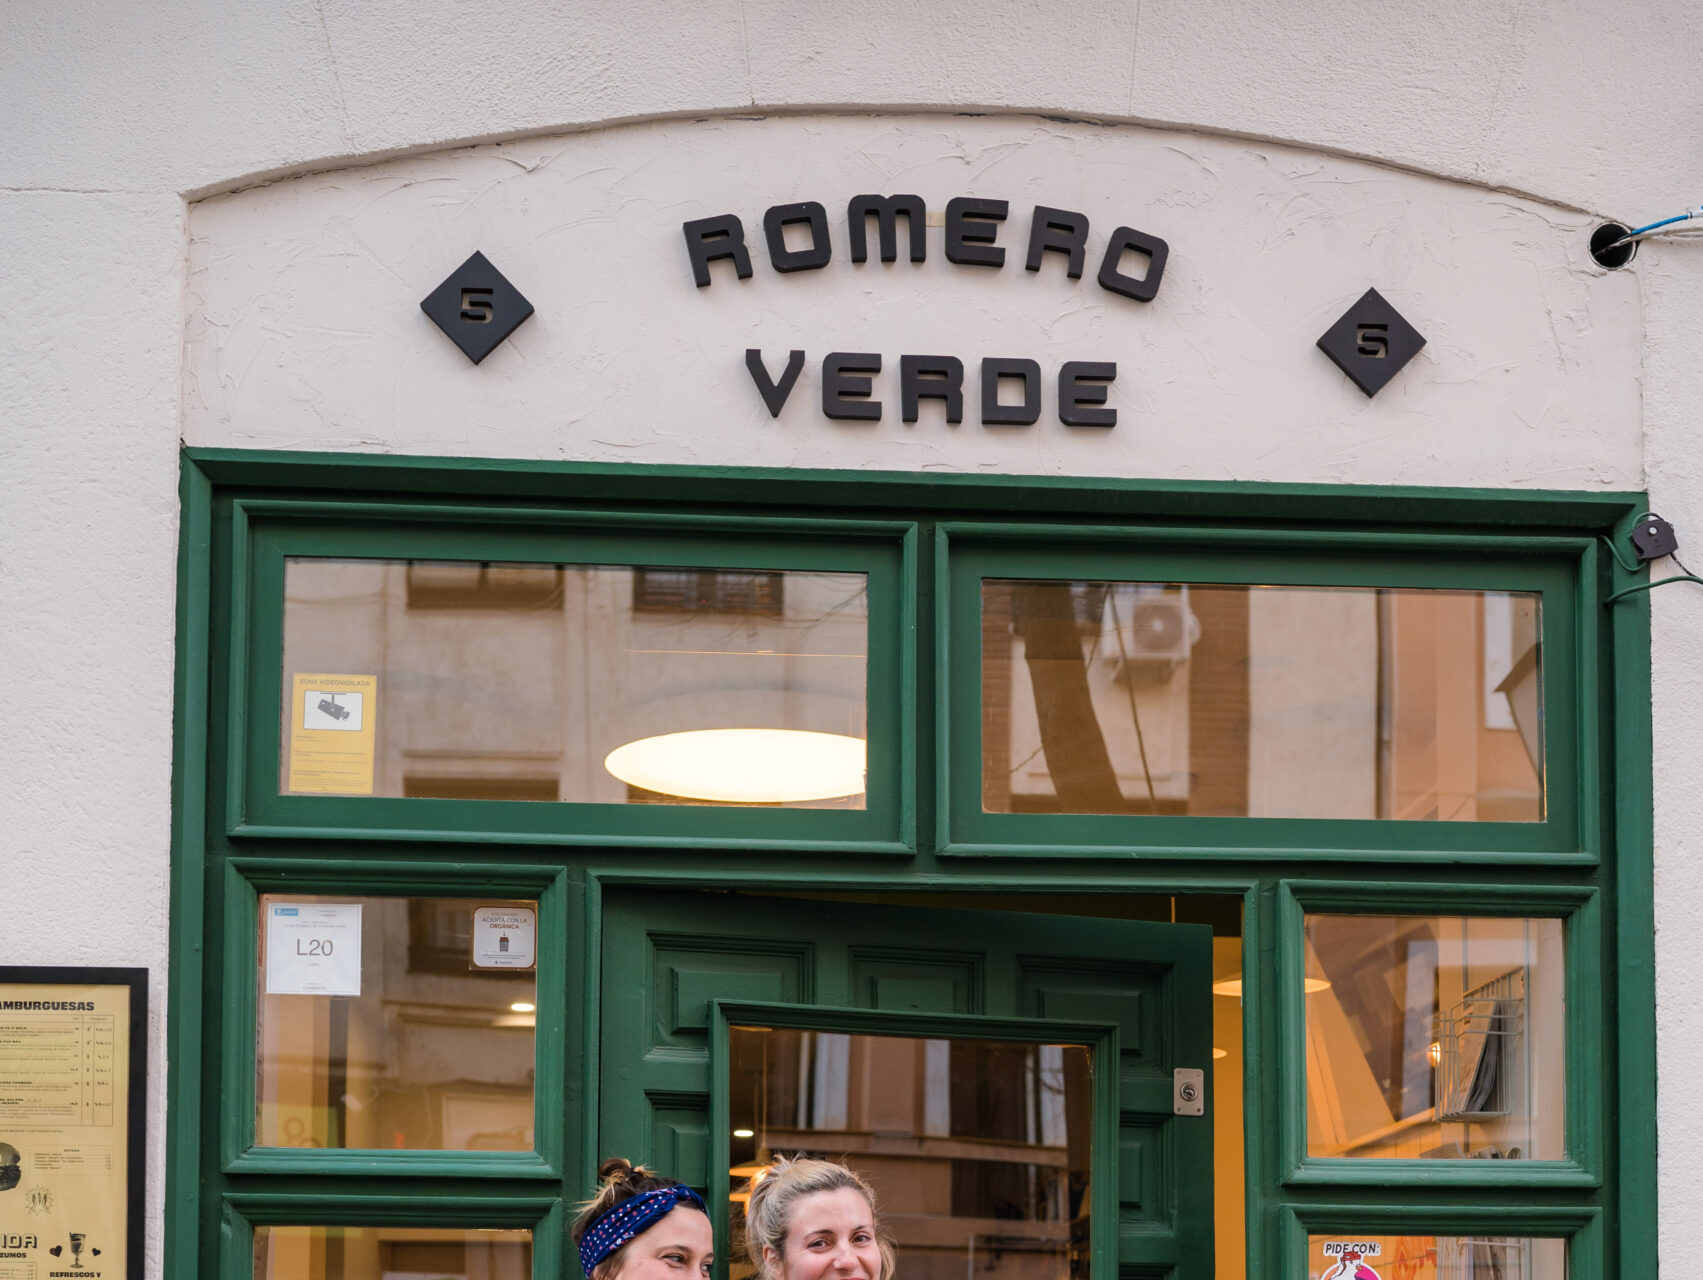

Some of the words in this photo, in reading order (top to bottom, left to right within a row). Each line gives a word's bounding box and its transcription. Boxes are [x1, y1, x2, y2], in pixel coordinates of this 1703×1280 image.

[683, 195, 1169, 303] ROMERO
[746, 348, 1117, 428] VERDE
[297, 938, 333, 957] L20
[0, 1001, 95, 1011] MBURGUESAS
[1325, 1244, 1349, 1254] PIDE
